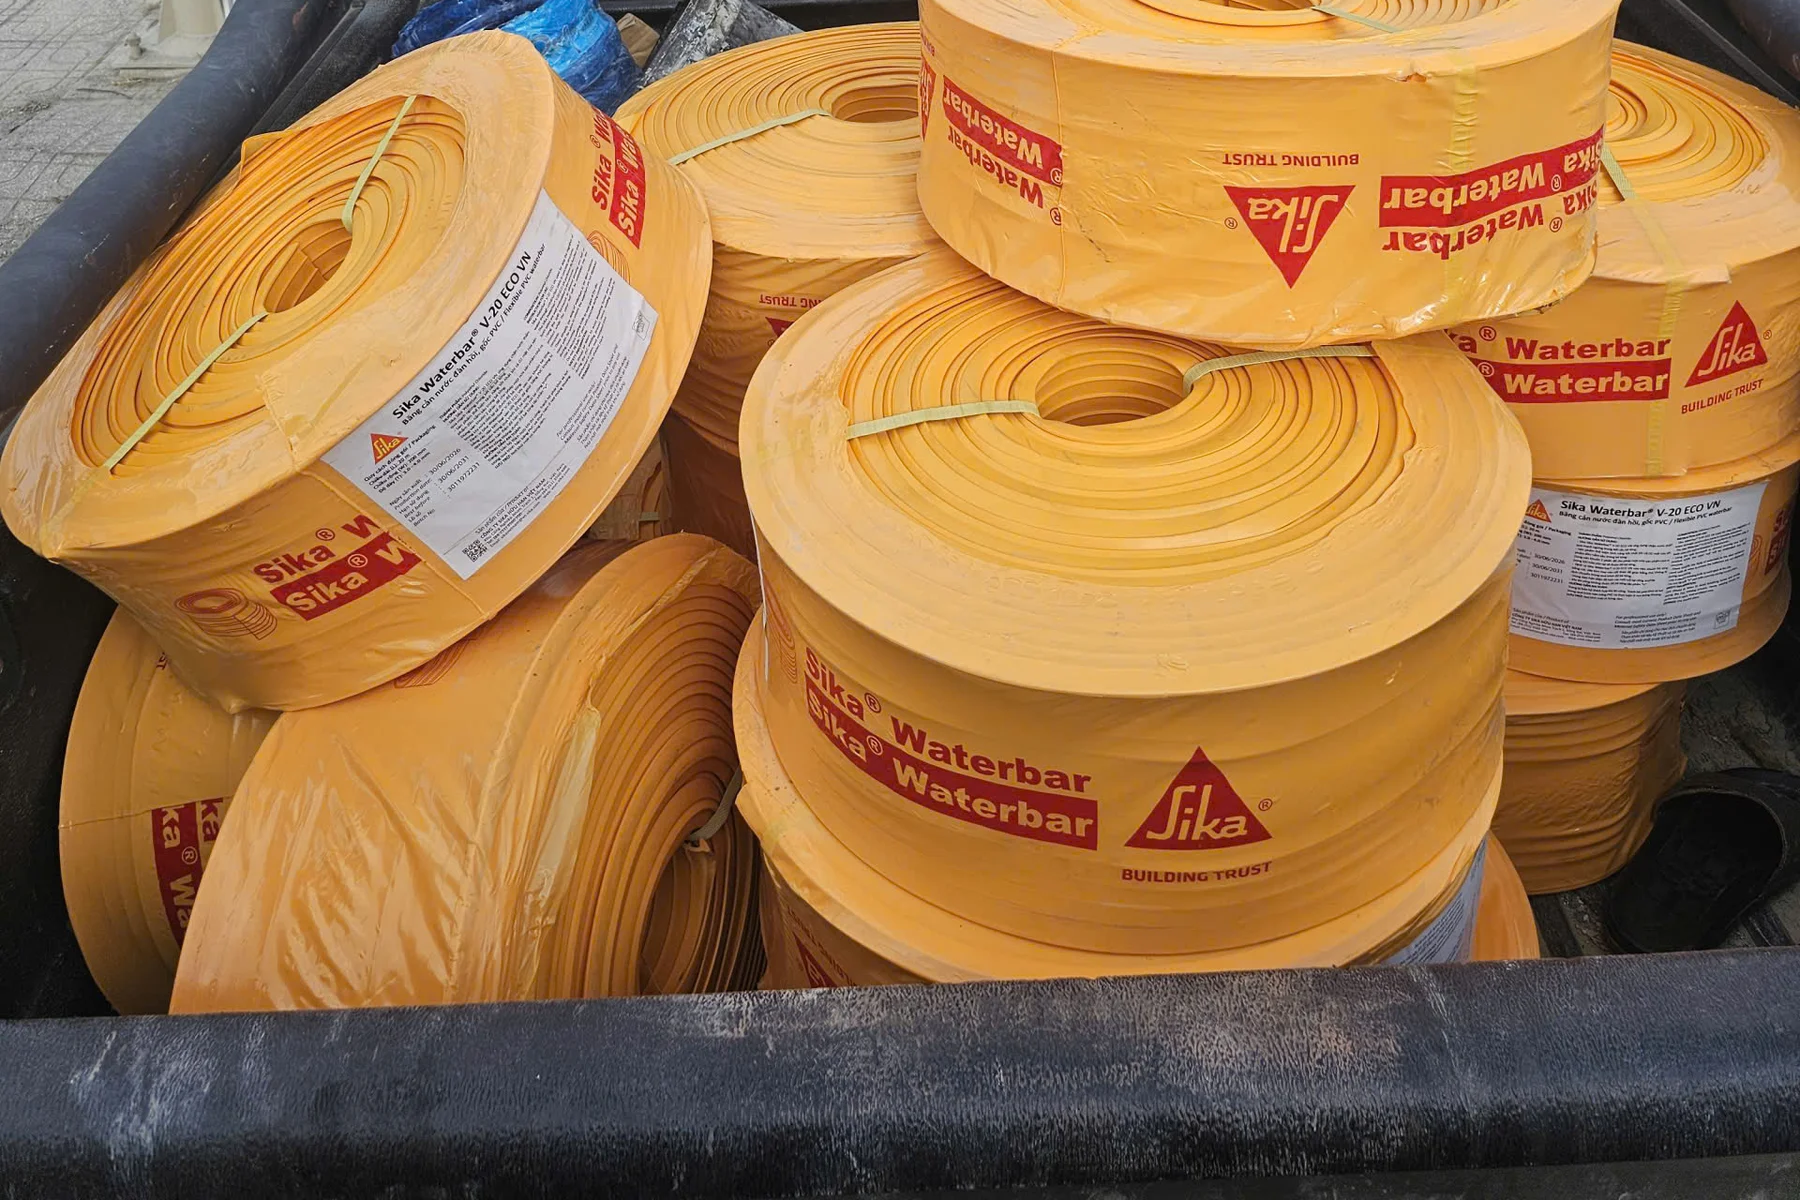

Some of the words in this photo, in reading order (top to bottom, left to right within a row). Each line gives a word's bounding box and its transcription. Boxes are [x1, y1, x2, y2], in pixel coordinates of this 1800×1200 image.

[943, 86, 1044, 169] Waterbar
[947, 125, 1044, 209] Waterbar
[1222, 152, 1277, 166] TRUST
[1282, 153, 1359, 167] BUILDING
[1382, 166, 1546, 216] Waterbar
[1247, 194, 1339, 254] Sika
[1382, 204, 1544, 261] Waterbar
[758, 293, 799, 308] TRUST
[392, 394, 421, 419] Sika
[479, 298, 503, 328] V-20
[500, 272, 520, 300] ECO
[516, 251, 532, 271] VN
[401, 408, 423, 426] Băng
[421, 396, 436, 409] cản
[434, 377, 454, 397] nước
[453, 363, 468, 378] đàn
[479, 336, 492, 352] gốc
[489, 320, 502, 338] PVC
[502, 289, 523, 317] Flexible
[520, 273, 532, 290] PVC
[529, 243, 546, 275] waterbar
[1505, 336, 1672, 361] Waterbar
[1697, 322, 1757, 377] Sika
[1503, 371, 1669, 396] Waterbar
[1681, 389, 1733, 415] BUILDING
[1734, 378, 1765, 398] TRUST
[373, 437, 402, 460] Sika
[410, 424, 437, 445] Packaging
[428, 447, 462, 476] 30/06/2026
[437, 455, 470, 484] 30/06/2031
[1560, 500, 1586, 512] Sika
[1656, 507, 1682, 517] V-20
[1683, 503, 1705, 515] ECO
[1706, 499, 1722, 510] VN
[890, 715, 1092, 794] Waterbar
[893, 756, 1094, 839] Waterbar
[1146, 783, 1248, 842] Sika
[1121, 866, 1210, 884] BUILDING
[1215, 860, 1273, 882] TRUST
